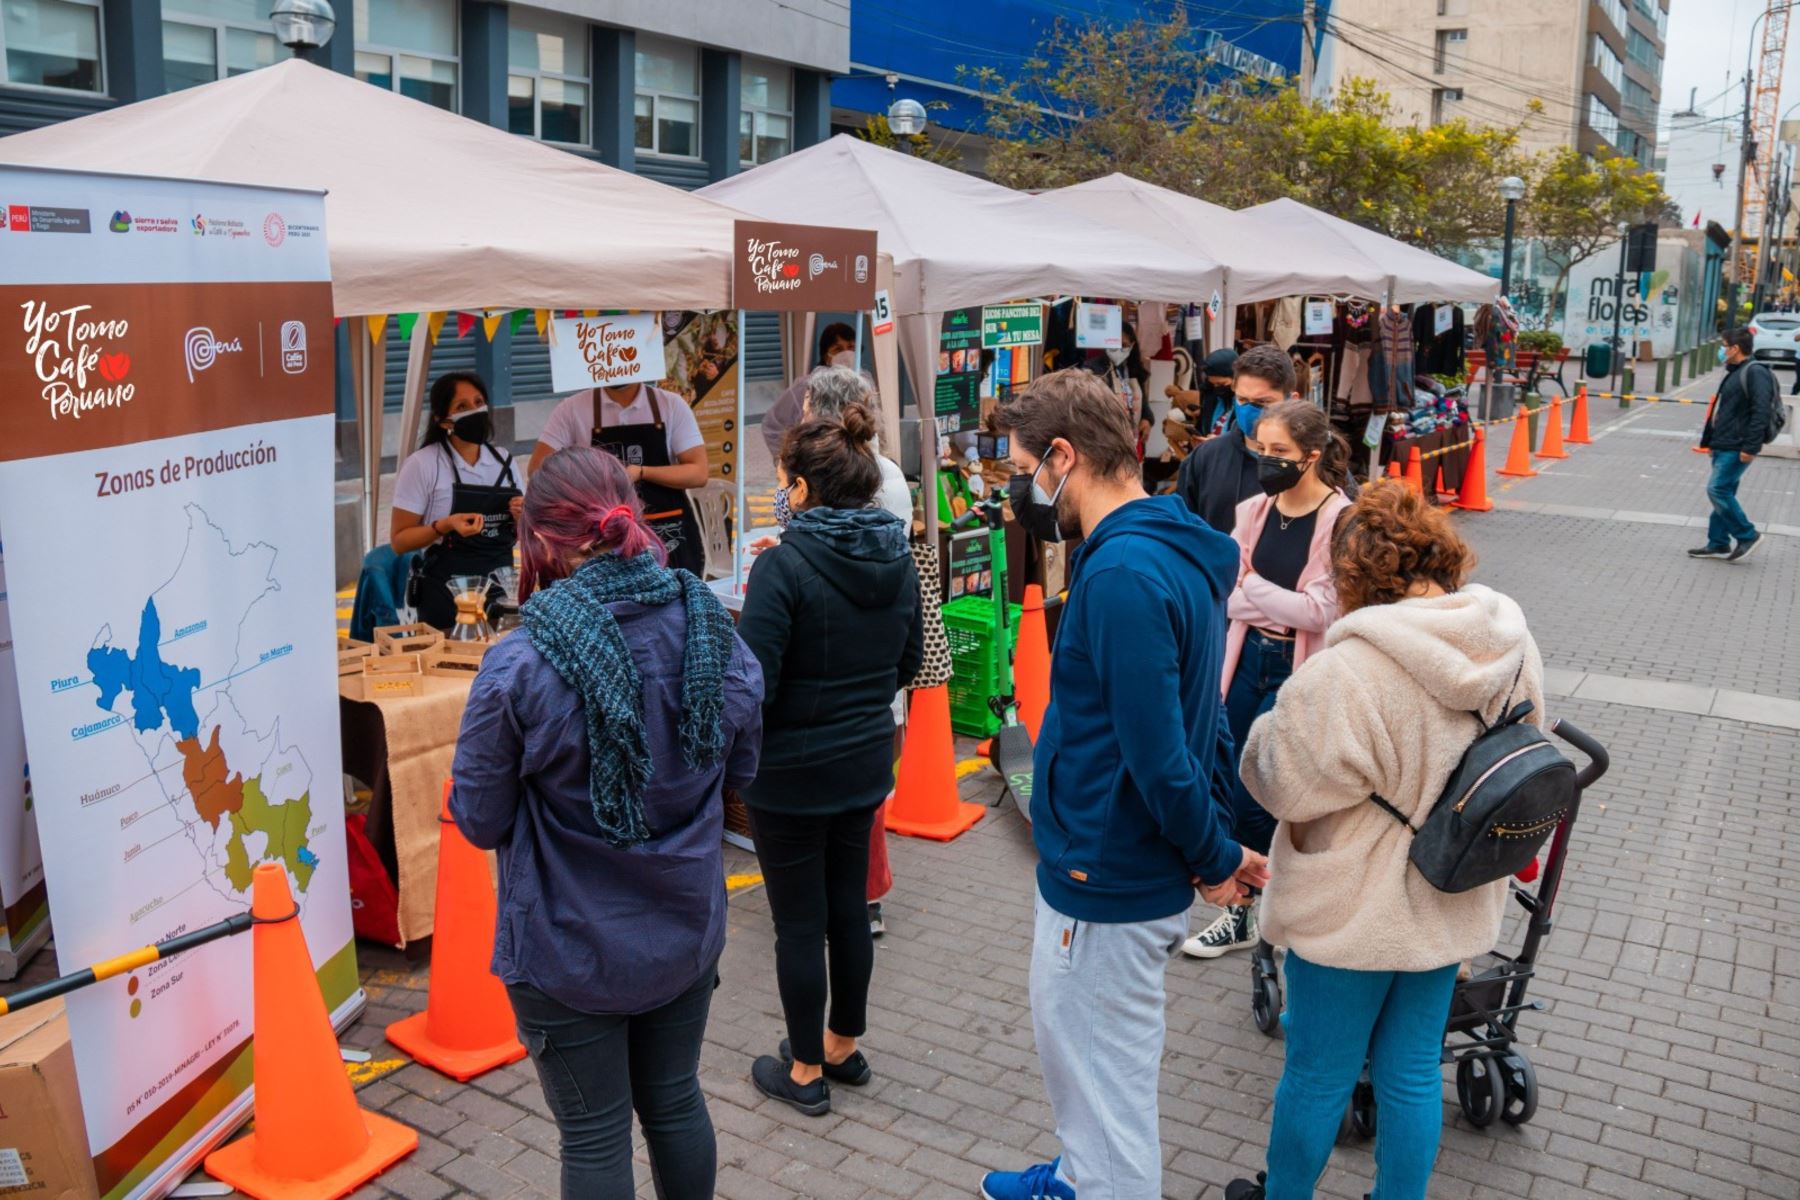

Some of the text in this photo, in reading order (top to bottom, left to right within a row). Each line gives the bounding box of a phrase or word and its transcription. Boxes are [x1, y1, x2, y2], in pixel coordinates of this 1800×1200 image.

[11, 213, 27, 222] PERÚ
[748, 238, 800, 262] Yo Tomo
[752, 256, 785, 280] Café
[754, 275, 801, 293] Peruano
[1588, 296, 1648, 322] floes
[20, 300, 128, 354] Yo Tomo
[576, 322, 635, 350] Yo Tomo
[35, 340, 102, 389] Café
[185, 326, 243, 384] Perú
[584, 342, 620, 367] Café
[588, 363, 640, 383] Peruano
[42, 381, 135, 420] Peruano
[95, 440, 277, 497] Zonas de Producción
[50, 674, 79, 690] Piura
[71, 714, 120, 738] Cajamarca
[80, 782, 120, 805] Huánuco
[166, 924, 186, 940] Norte
[148, 960, 168, 976] Zona
[151, 972, 183, 999] Zona Sur
